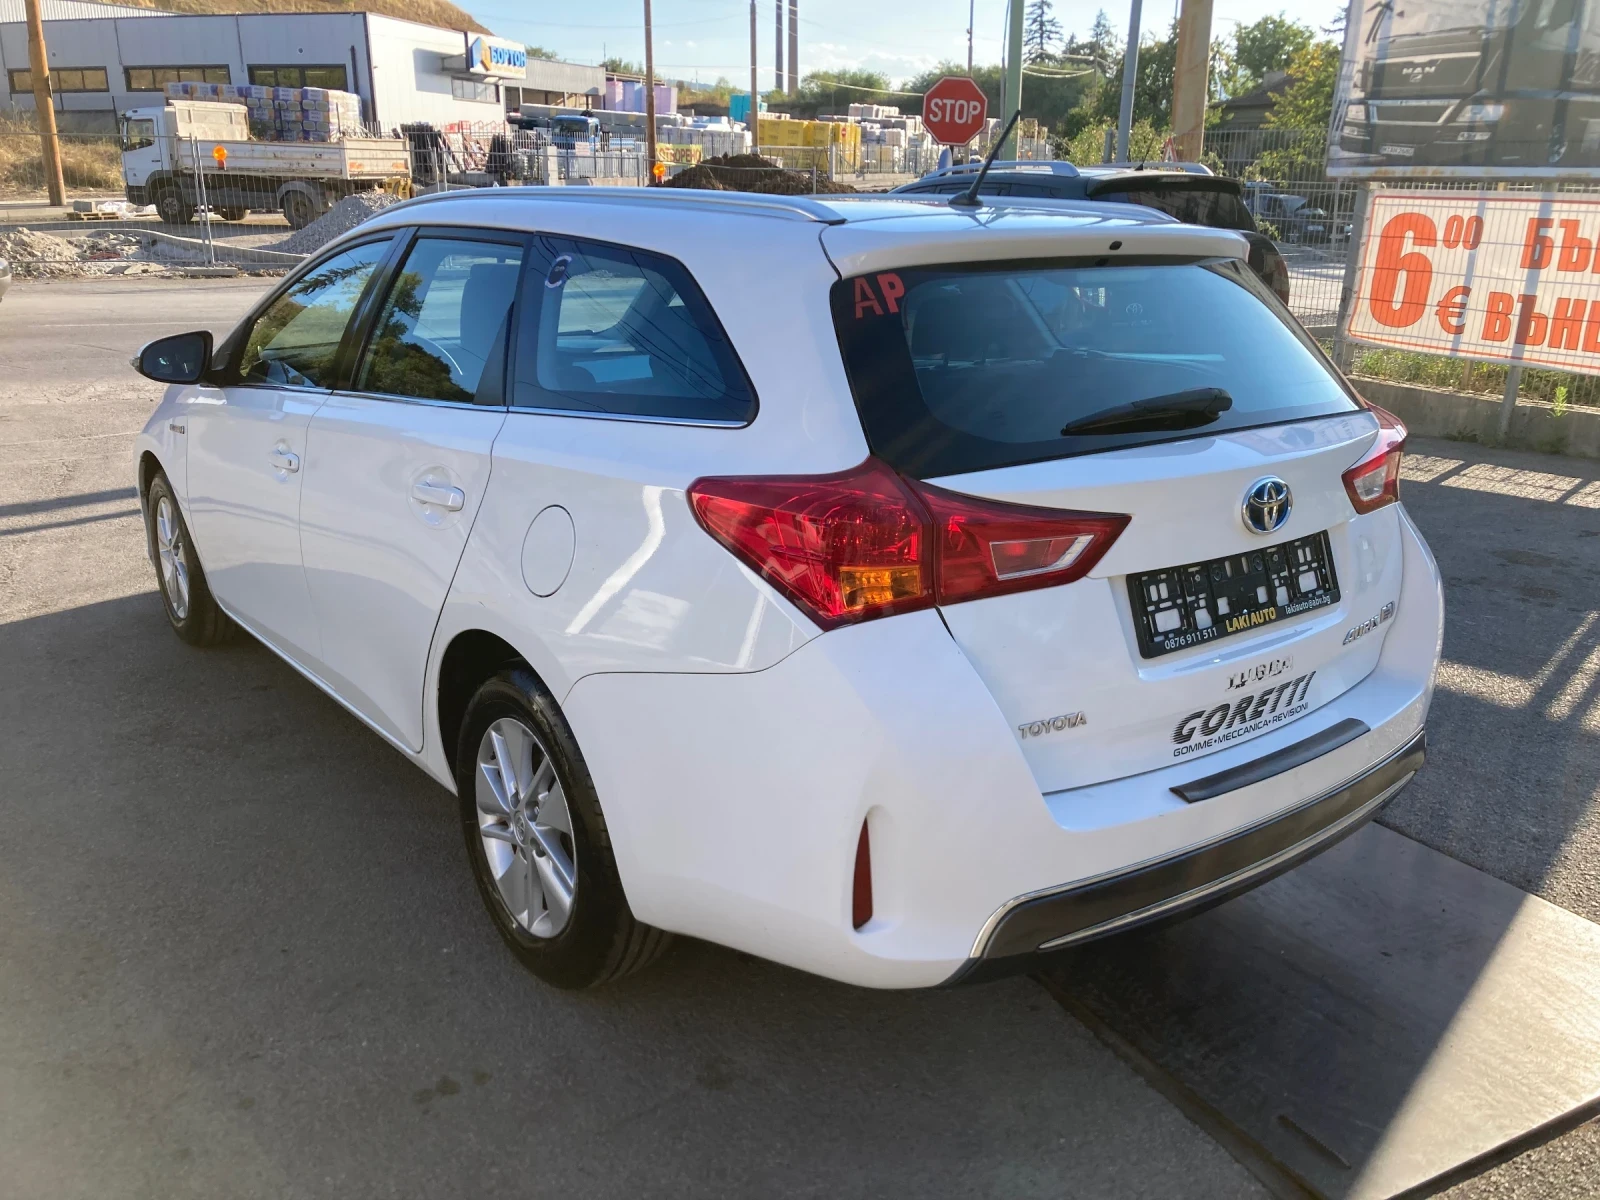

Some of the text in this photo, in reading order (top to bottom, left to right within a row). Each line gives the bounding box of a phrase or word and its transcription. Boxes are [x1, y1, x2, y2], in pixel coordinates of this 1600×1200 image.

[491, 46, 526, 68] БОРТОН
[1402, 65, 1436, 75] MAN
[929, 98, 981, 124] STOP
[1370, 212, 1437, 328] 6
[1520, 217, 1600, 275] БЪ
[854, 272, 905, 319] AP
[1285, 595, 1331, 615] lakiauto@abv.bg
[1226, 607, 1276, 633] LAKI AUTO
[1164, 627, 1217, 650] 0876 911 511
[1171, 670, 1317, 744] GORETTI
[1018, 711, 1087, 740] TOYOTA
